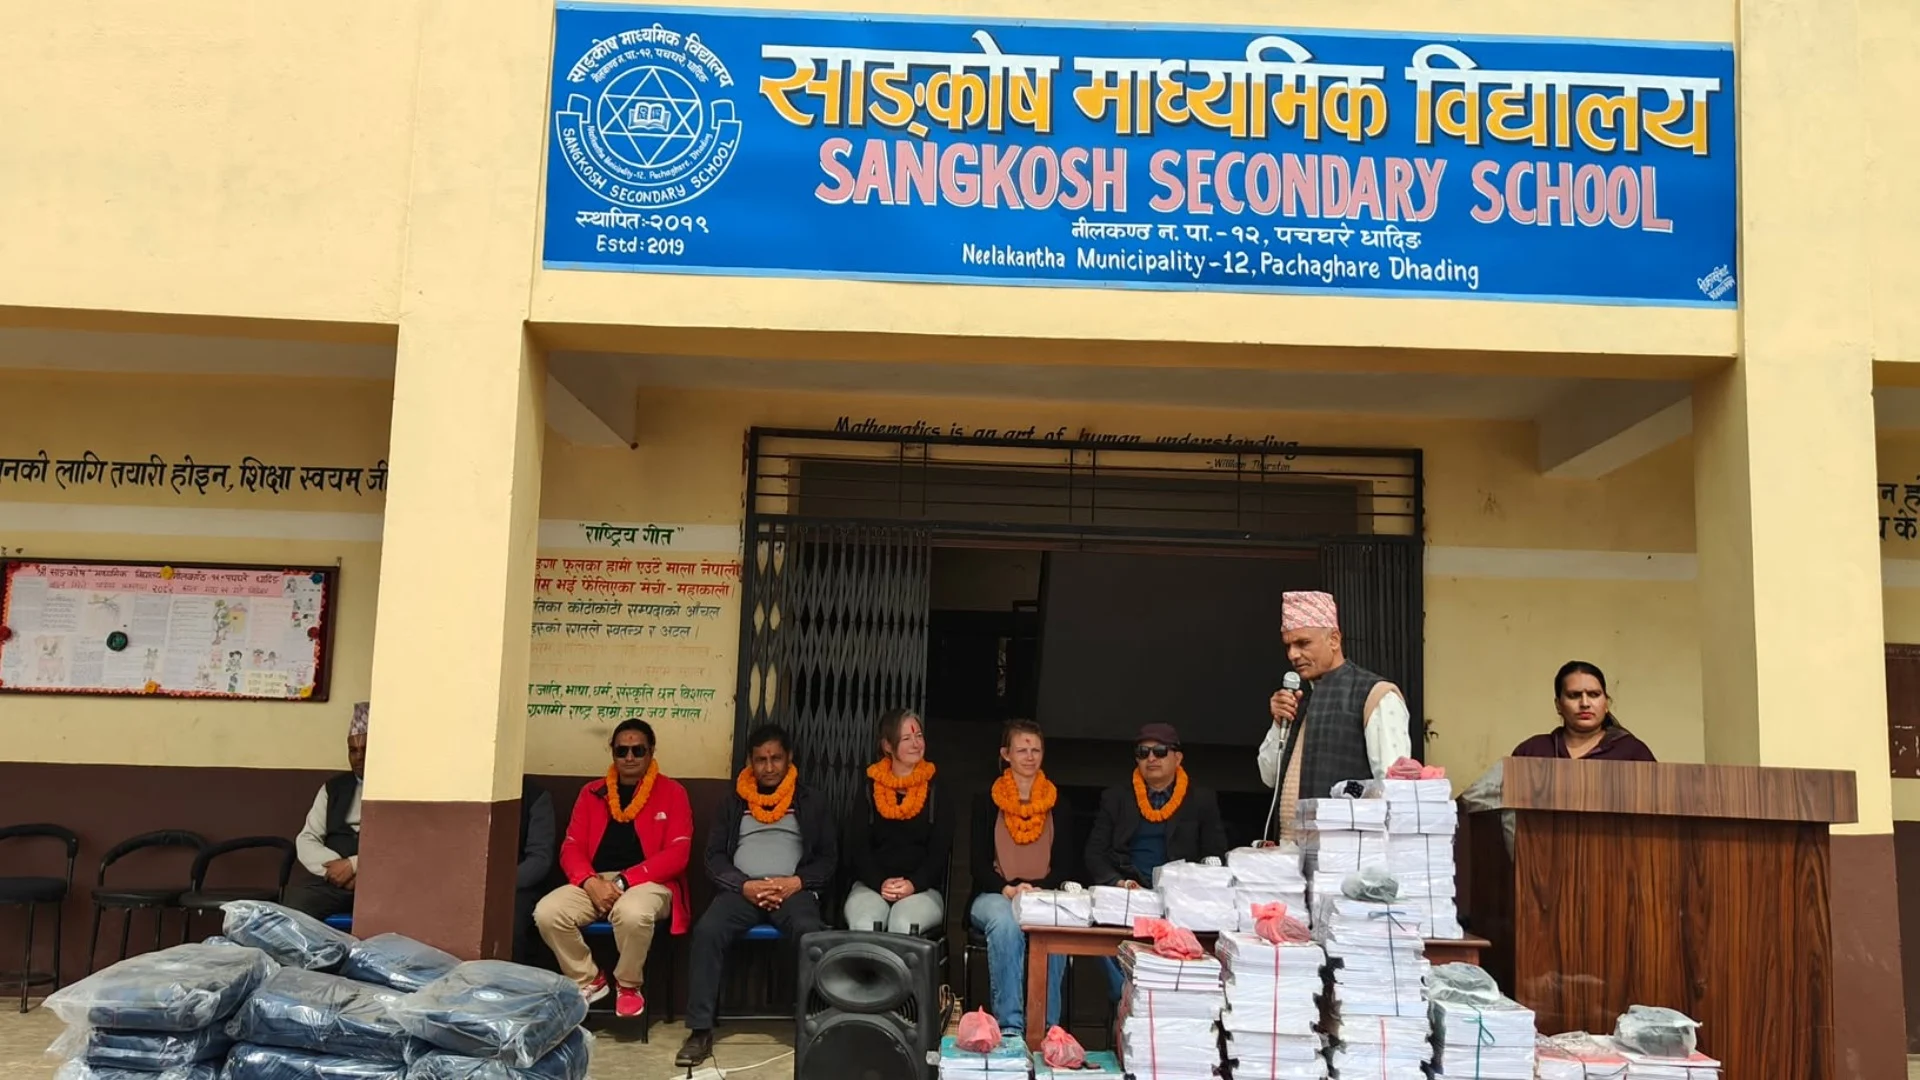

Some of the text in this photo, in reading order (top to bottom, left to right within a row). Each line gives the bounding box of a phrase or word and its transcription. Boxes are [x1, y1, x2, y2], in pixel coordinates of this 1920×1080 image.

[618, 22, 681, 46] माध्यमिक
[684, 32, 734, 88] विद्यालय
[1073, 36, 1388, 141] माध्यमिक
[1405, 44, 1721, 155] विद्यालय
[562, 127, 735, 203] SANGKOSH SECONDARY SCHOOL
[815, 138, 1674, 233] SANGKOSH SECONDARY SCHOOL
[1071, 215, 1153, 241] नीलकण्ठ
[1157, 223, 1180, 242] न.
[1273, 222, 1355, 248] पचघरे
[1360, 225, 1422, 253] धादिङ
[962, 242, 1066, 269] Neelakantha
[1260, 253, 1381, 283] Pachaghare
[1388, 256, 1479, 290] Dhading
[835, 416, 940, 436] Mathematics
[950, 422, 963, 437] is
[973, 427, 997, 439] an
[1004, 425, 1035, 440] art
[1044, 426, 1067, 441] of
[1079, 427, 1141, 444] human
[0, 450, 50, 484] नको
[56, 450, 108, 490] लागि
[111, 454, 167, 488] तयारी
[170, 454, 234, 494] होइन,
[239, 456, 295, 494] शिक्षा
[300, 466, 363, 496] स्वयम्
[556, 575, 577, 595] भई
[562, 558, 603, 576] फूलका
[606, 557, 633, 577] हामी
[666, 562, 697, 578] माला
[700, 559, 741, 580] नेपाली
[627, 600, 680, 618] सम्पदाको
[566, 619, 602, 639] रगतले
[606, 623, 643, 639] स्वतन्त्र
[649, 625, 656, 638] र
[660, 626, 692, 640] अटल
[616, 682, 654, 703] संस्कृति
[680, 684, 715, 702] विशाल
[569, 705, 593, 720] राष्ट्र
[625, 706, 645, 718] जय
[648, 706, 667, 718] जय
